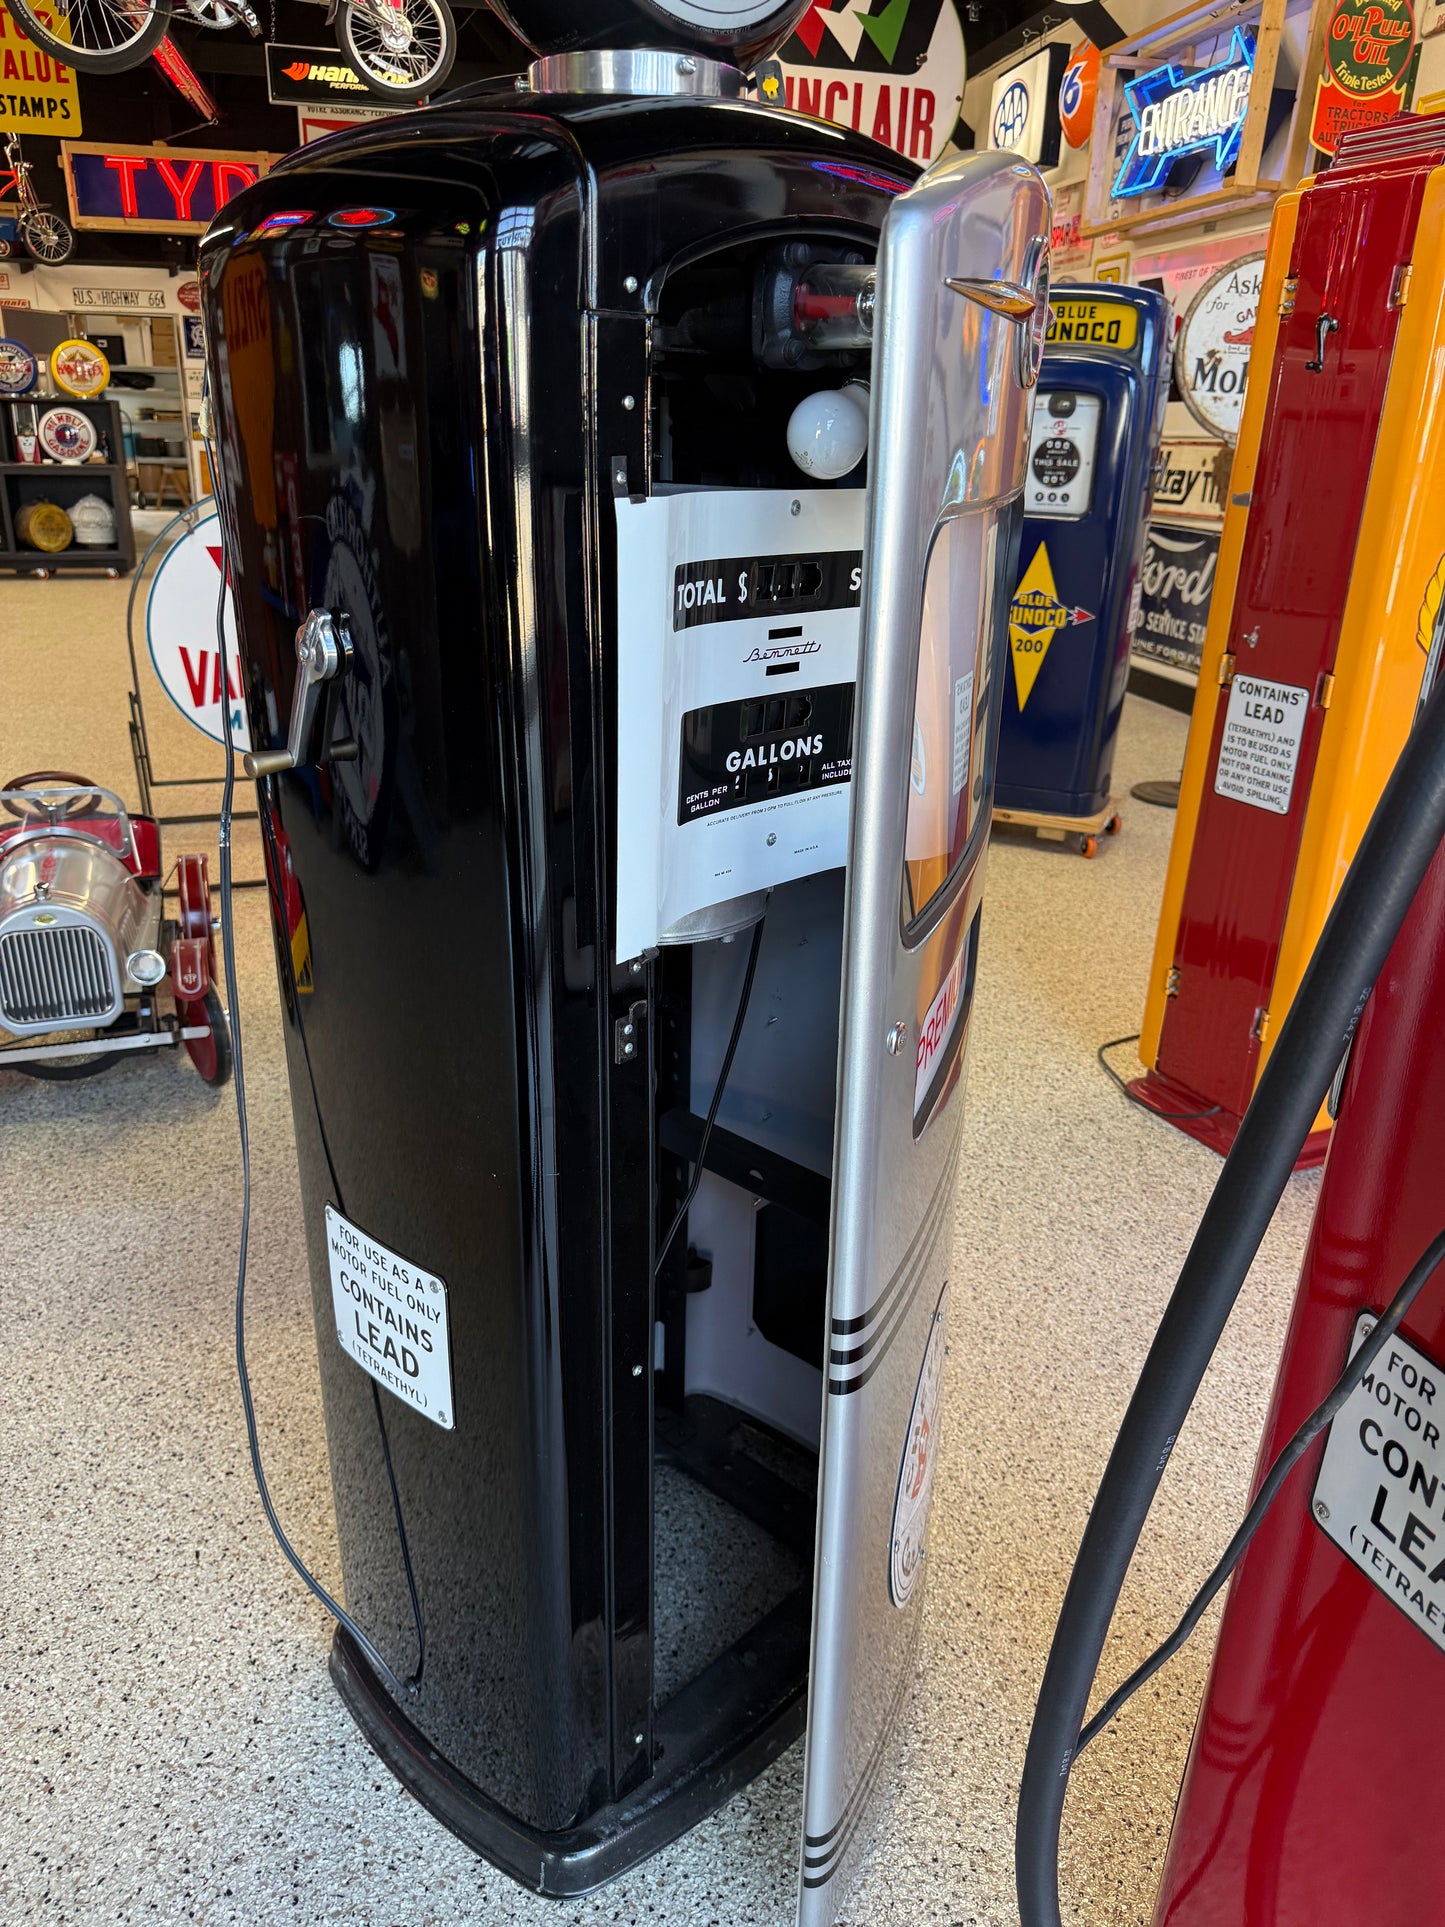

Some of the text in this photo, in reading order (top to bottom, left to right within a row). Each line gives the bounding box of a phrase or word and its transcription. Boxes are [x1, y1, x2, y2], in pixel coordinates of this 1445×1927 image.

[1363, 6, 1411, 38] PULL
[1353, 35, 1396, 66] OIL
[1335, 60, 1394, 91] Triple Tested
[1138, 66, 1250, 156] ENTRANCE
[1327, 106, 1390, 123] TRACTORS
[1226, 271, 1262, 298] Ask
[77, 291, 161, 307] U.S. HIGHWAY 66
[1206, 296, 1230, 314] for
[1057, 306, 1096, 319] BLUE
[48, 438, 89, 457] GASOLINE
[1056, 459, 1079, 468] SALE
[677, 578, 726, 610] TOTAL
[738, 571, 748, 604] $
[1018, 594, 1053, 607] BLUE
[1012, 607, 1067, 628] UNOCO
[1145, 611, 1188, 640] SERVICE
[743, 641, 821, 663] Bennett
[1015, 639, 1044, 653] 200
[1239, 681, 1300, 706] CONTAINS
[1244, 701, 1284, 724] LEAD
[1227, 735, 1292, 759] IS TO BE USED AS
[1228, 722, 1295, 747] (TETRAETHYL) AND
[725, 733, 824, 773] GALLONS
[822, 761, 836, 770] ALL
[1222, 746, 1248, 759] MOTOR
[1250, 753, 1268, 765] FUEL
[1219, 768, 1229, 776] OR
[1231, 771, 1245, 783] ANY
[1247, 776, 1271, 789] OTHER
[1221, 757, 1291, 784] NOT FOR CLEANING
[686, 785, 728, 804] CENTS PER
[1222, 781, 1244, 794] AVOID
[690, 797, 720, 813] GALLON
[706, 817, 730, 827] ACCURATE
[730, 811, 751, 821] DELIVERY
[751, 808, 764, 816] FROM
[821, 790, 843, 799] PRESSURE
[916, 942, 968, 1071] PREMIUM
[340, 1225, 425, 1294] FOR USE AS A
[331, 1238, 441, 1324] MOTOR FUEL ONLY
[339, 1270, 434, 1353] CONTAINS
[354, 1310, 420, 1379] LEAD
[351, 1338, 428, 1409] (TETRAETHYL)
[1387, 1351, 1437, 1406] FOR
[1361, 1372, 1440, 1450] MOTOR
[1359, 1418, 1445, 1509] CON
[1349, 1524, 1445, 1635] (TETRAE
